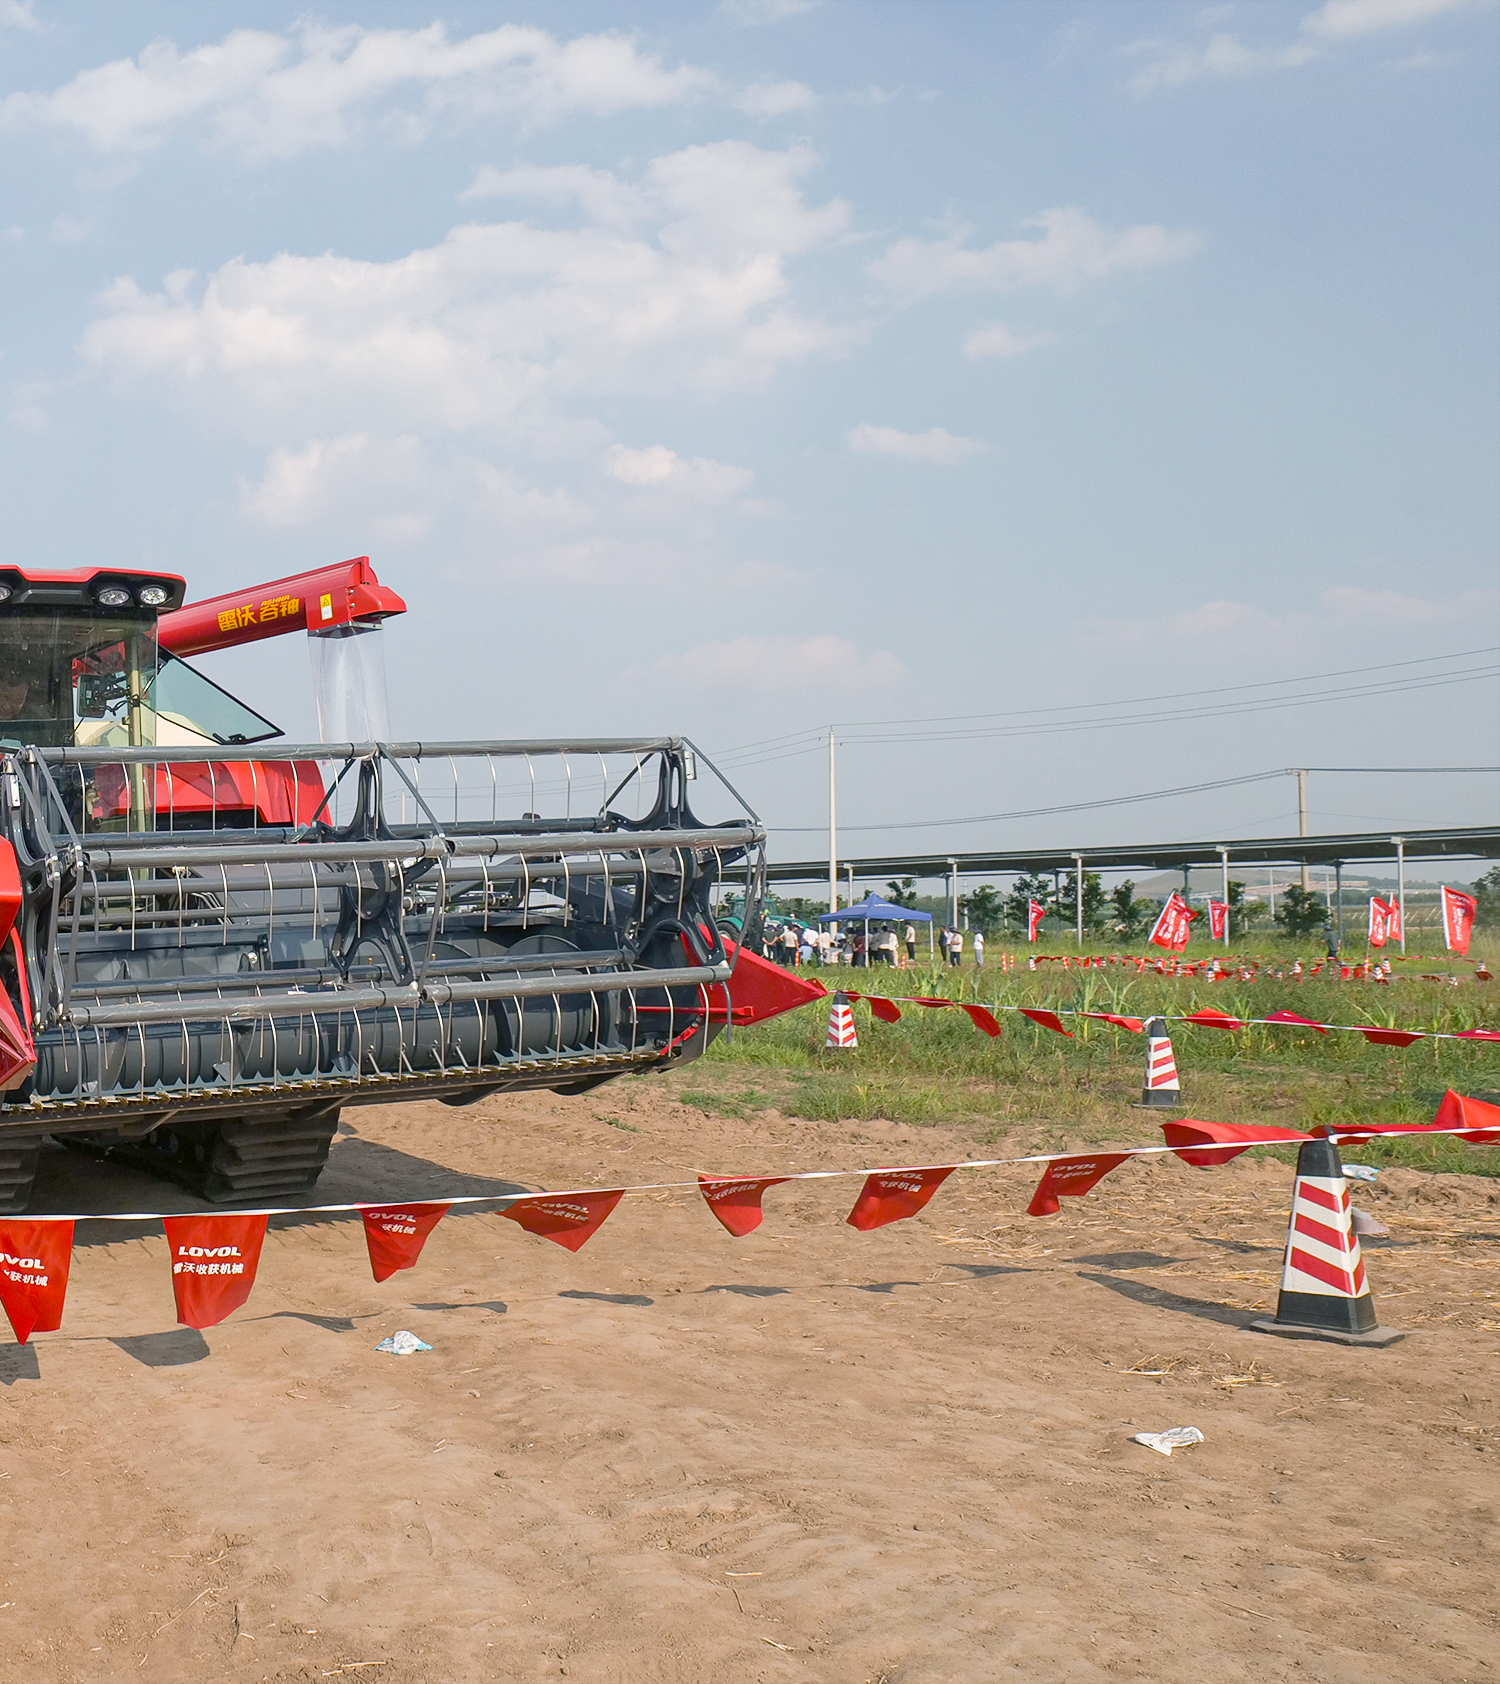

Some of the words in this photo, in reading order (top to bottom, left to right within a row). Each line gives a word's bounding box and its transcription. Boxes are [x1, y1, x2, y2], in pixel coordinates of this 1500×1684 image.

[178, 1245, 242, 1257] LOVOL
[3, 1269, 49, 1287] 获机械
